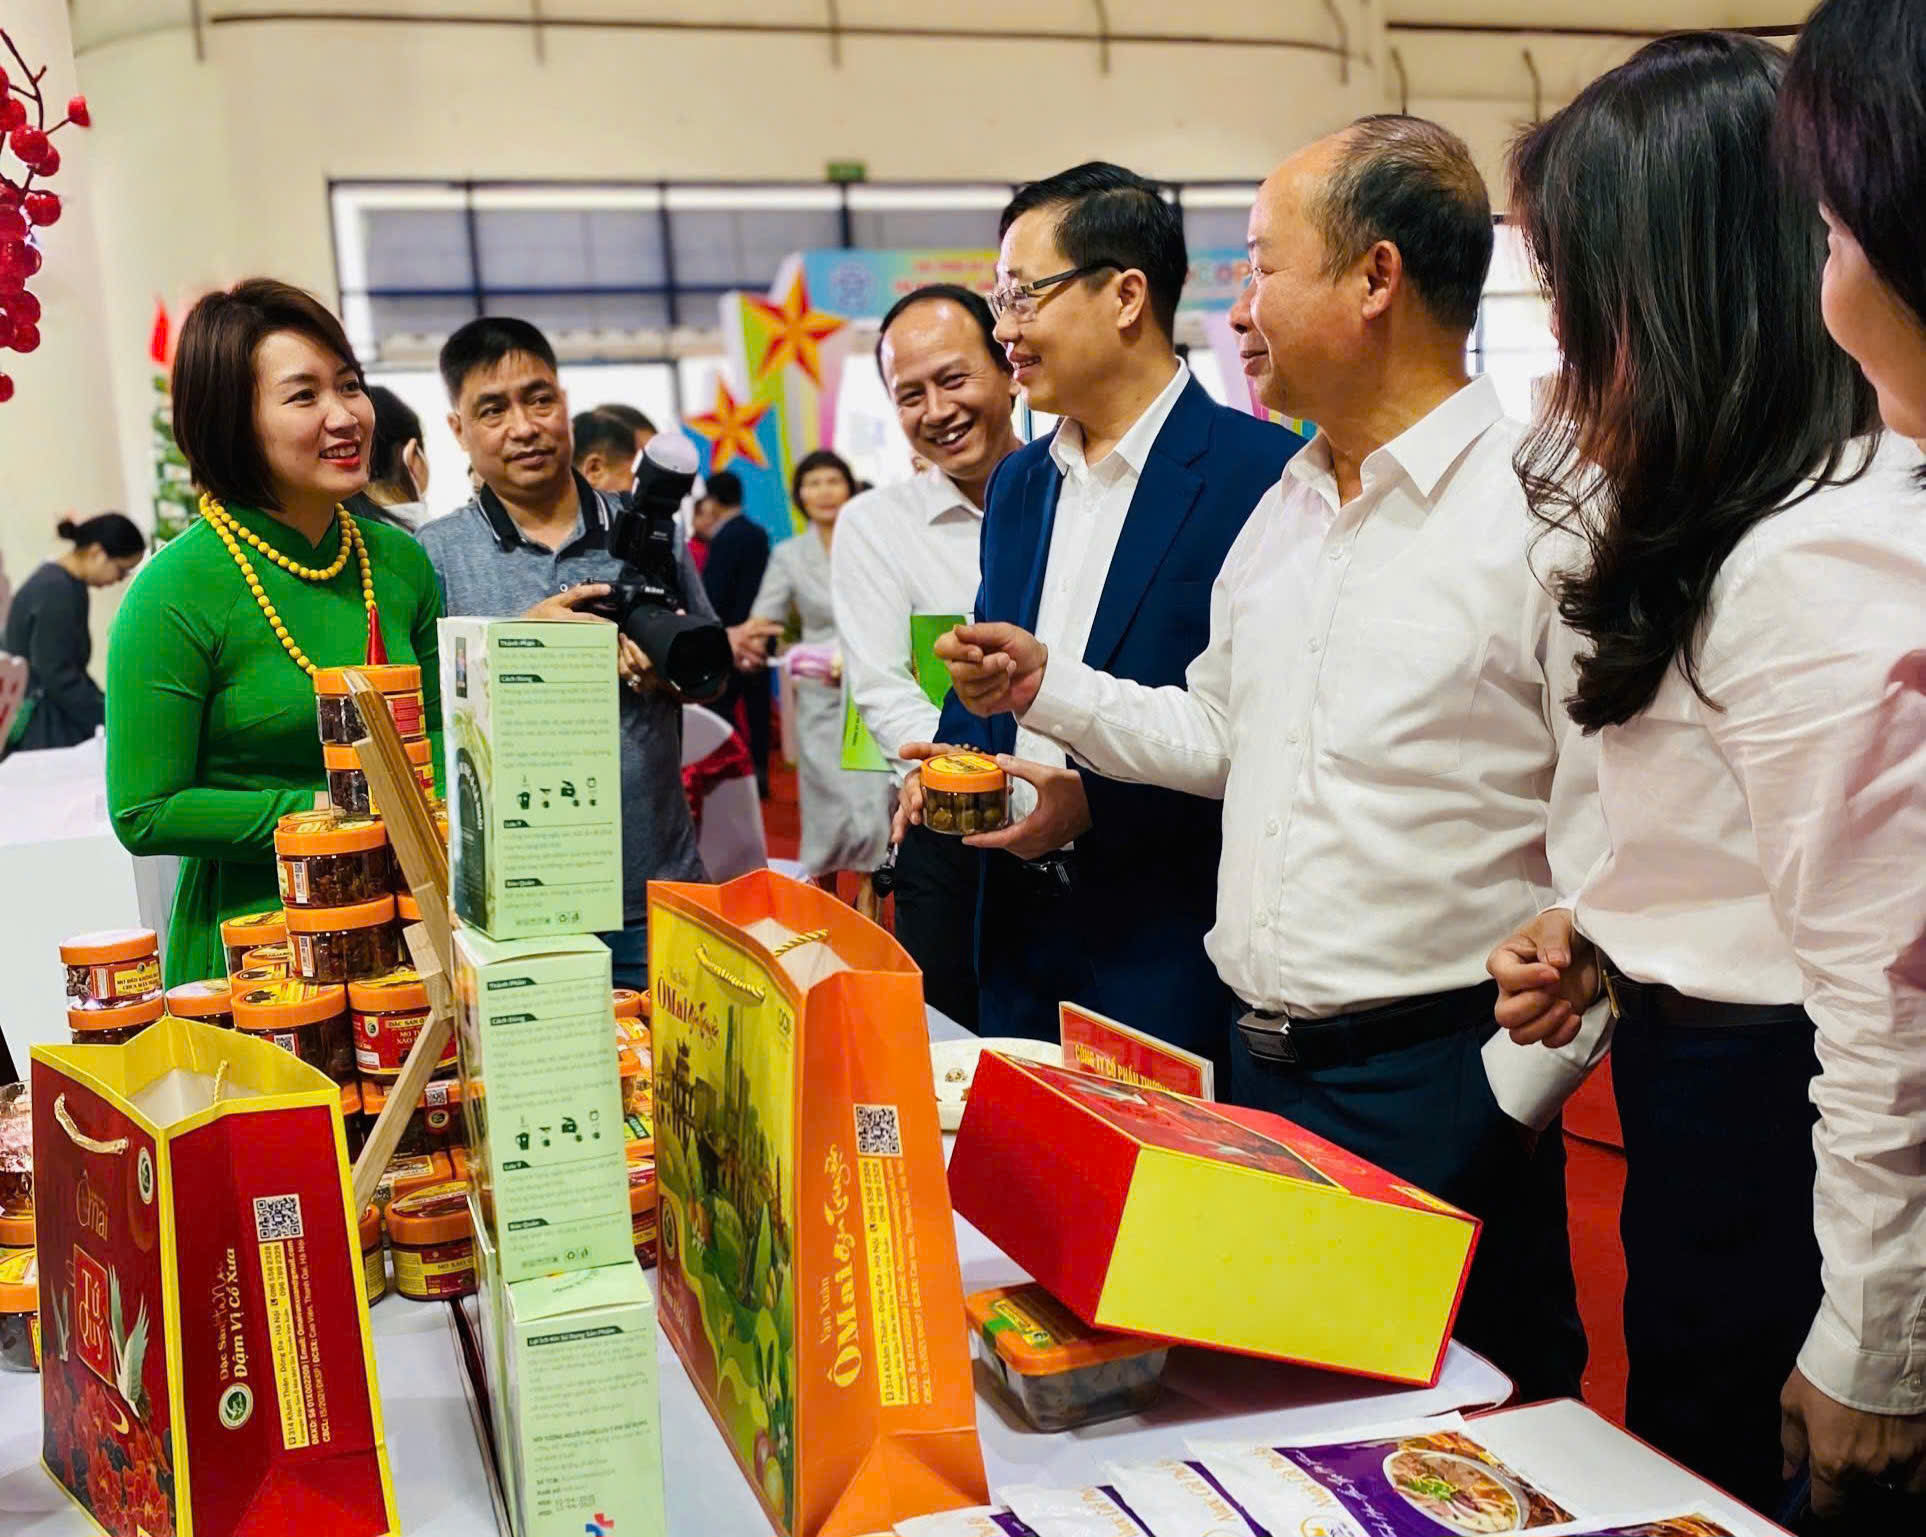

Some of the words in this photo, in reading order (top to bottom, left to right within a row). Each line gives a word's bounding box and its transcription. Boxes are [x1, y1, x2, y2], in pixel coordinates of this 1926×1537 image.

[644, 586, 664, 594] Nikon
[1074, 1044, 1095, 1066] CÔNG
[1096, 1055, 1105, 1072] TY
[1106, 1056, 1116, 1078] CỔ
[1118, 1064, 1139, 1085] PHẦN
[225, 1247, 238, 1282] Xưa
[82, 1269, 100, 1318] Tứ
[225, 1286, 240, 1307] Cổ
[79, 1302, 104, 1361] Quý
[229, 1312, 245, 1331] Vị
[230, 1334, 249, 1377] Đậm
[287, 1421, 296, 1435] 314
